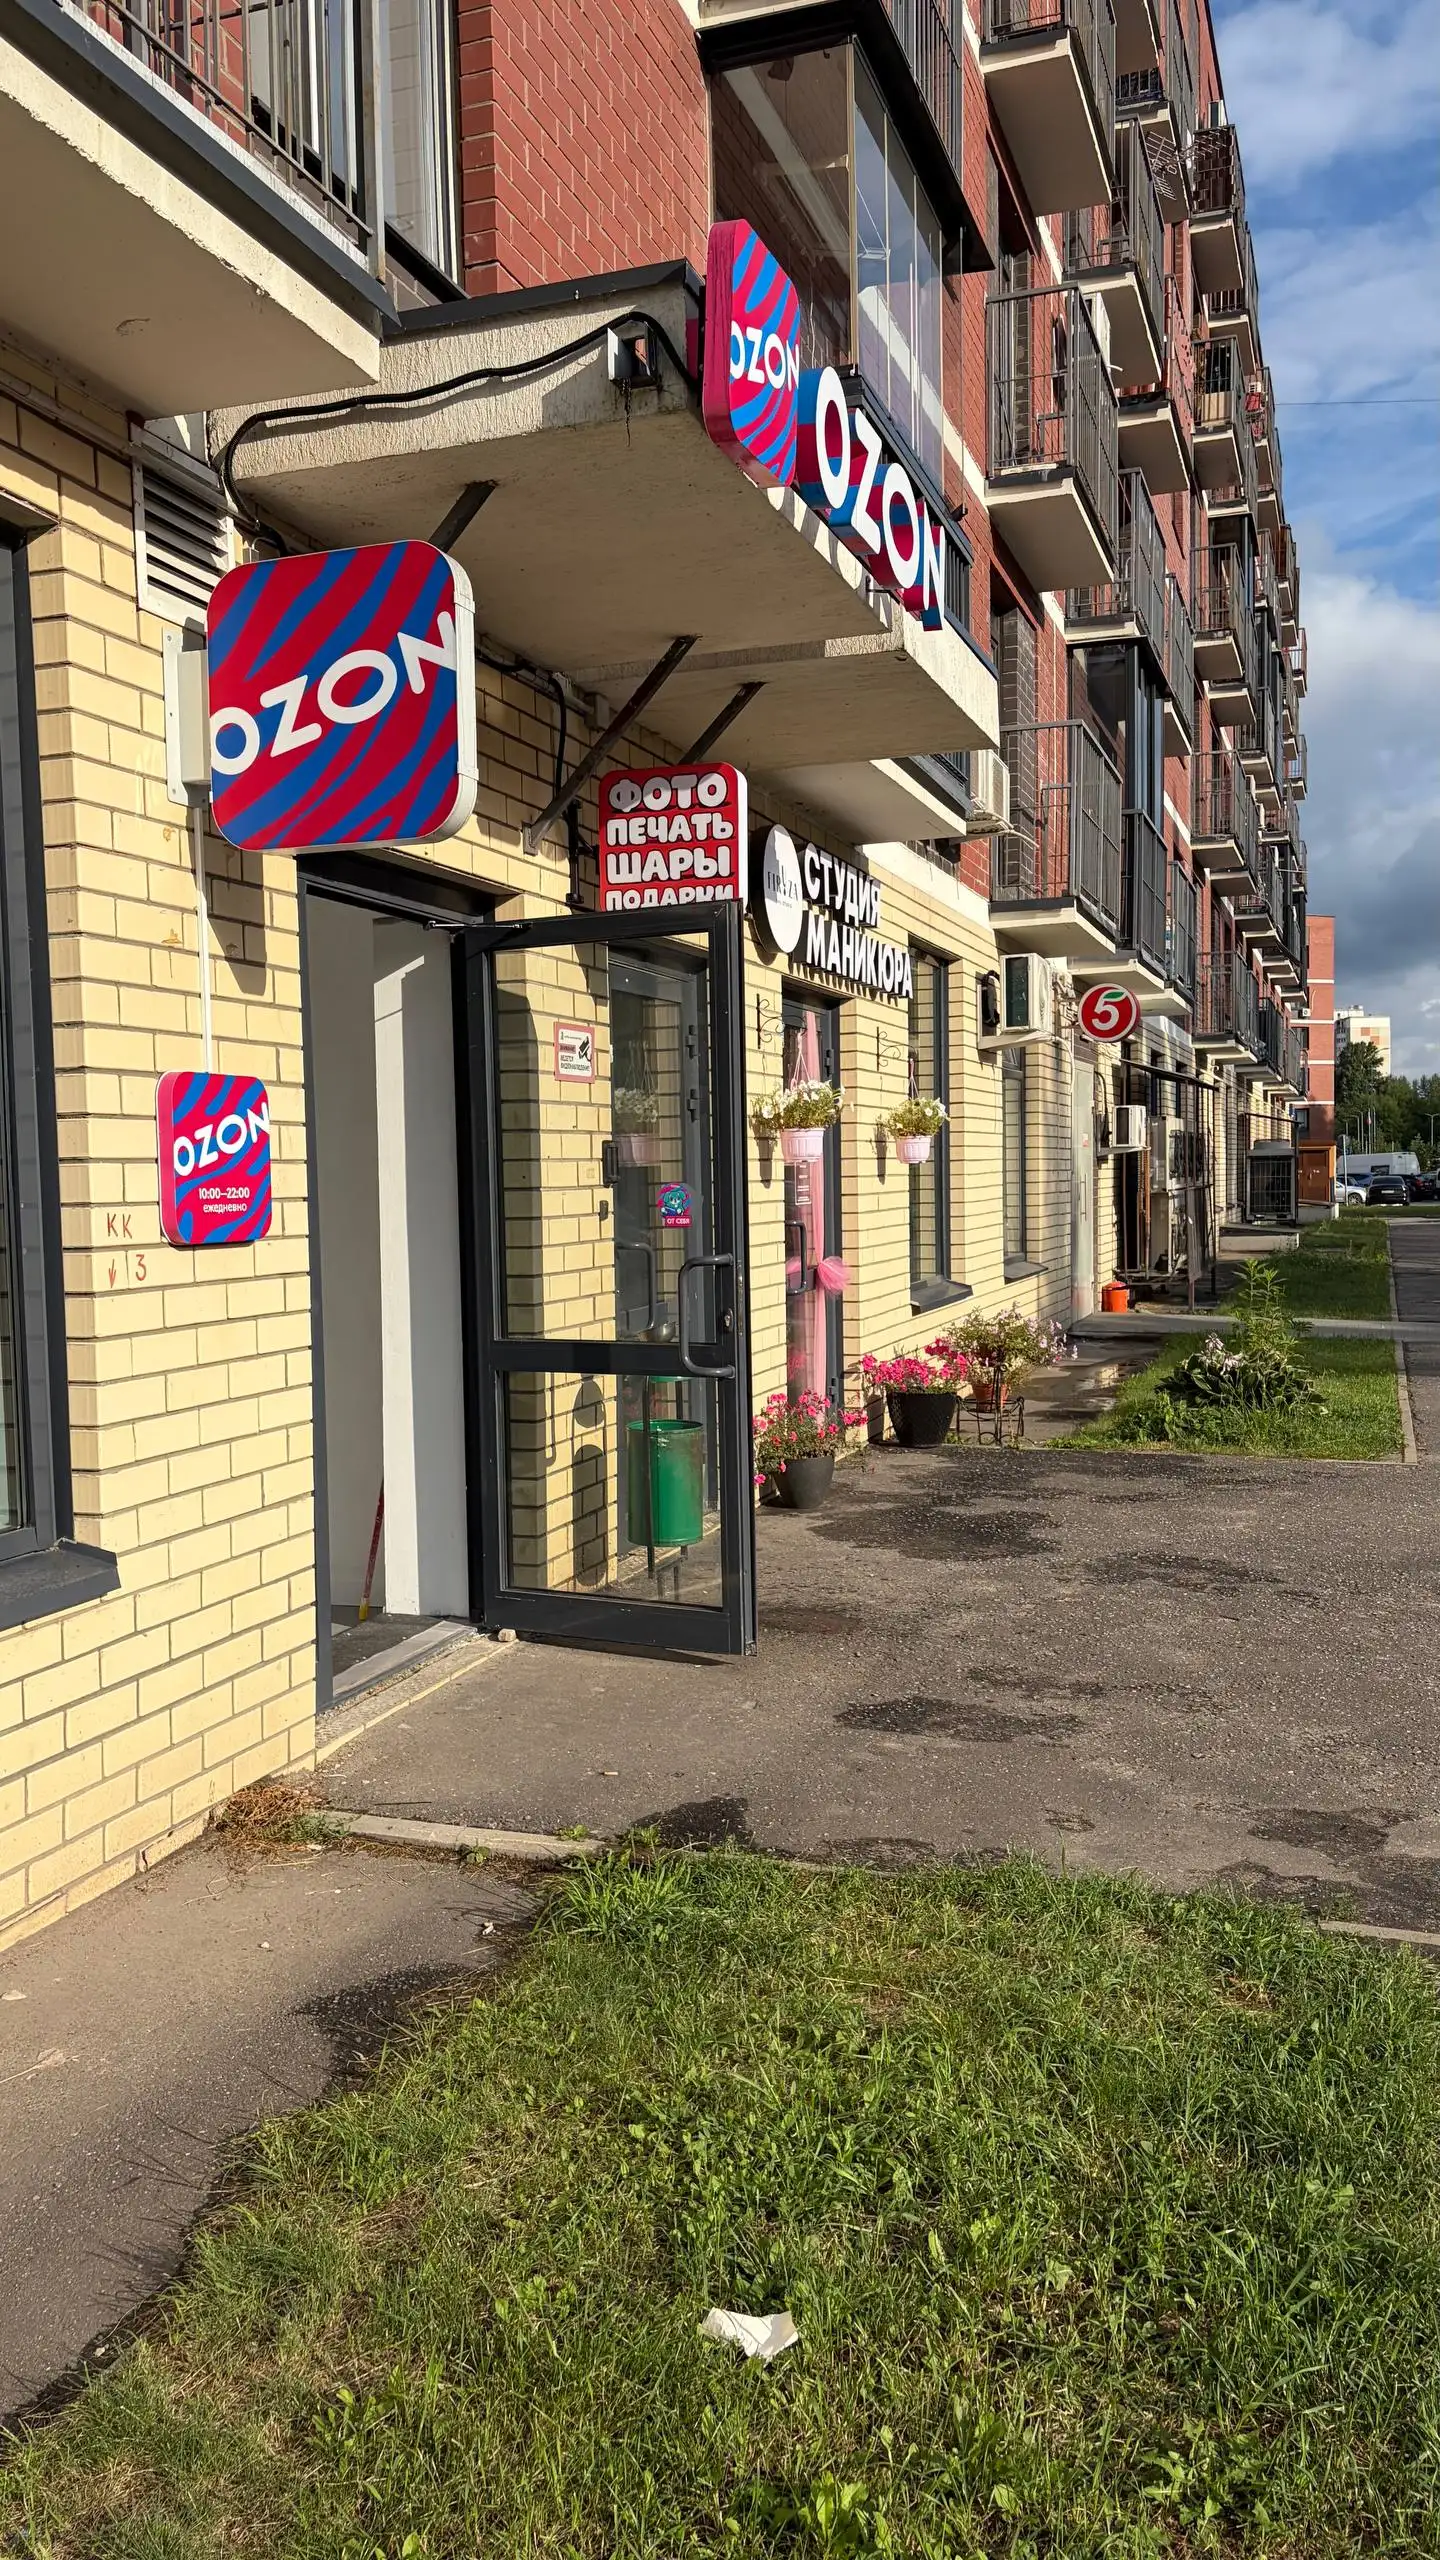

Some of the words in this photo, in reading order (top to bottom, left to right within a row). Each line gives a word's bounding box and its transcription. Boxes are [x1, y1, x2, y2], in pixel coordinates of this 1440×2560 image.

[729, 319, 799, 392] OZON
[815, 365, 946, 619] OZON
[210, 611, 457, 776] OZON
[608, 772, 728, 813] ФОТО
[605, 812, 734, 846] ПЕЧАТЬ
[606, 845, 732, 884] ШАРЫ
[804, 842, 881, 927] СТУДИЯ
[605, 884, 734, 912] ПОДАРКИ
[806, 909, 914, 1000] МАНИКЮРА
[1091, 988, 1127, 1031] 5
[173, 1102, 270, 1176] OZON
[203, 1203, 248, 1214] ежедневно
[136, 1254, 147, 1281] 3
